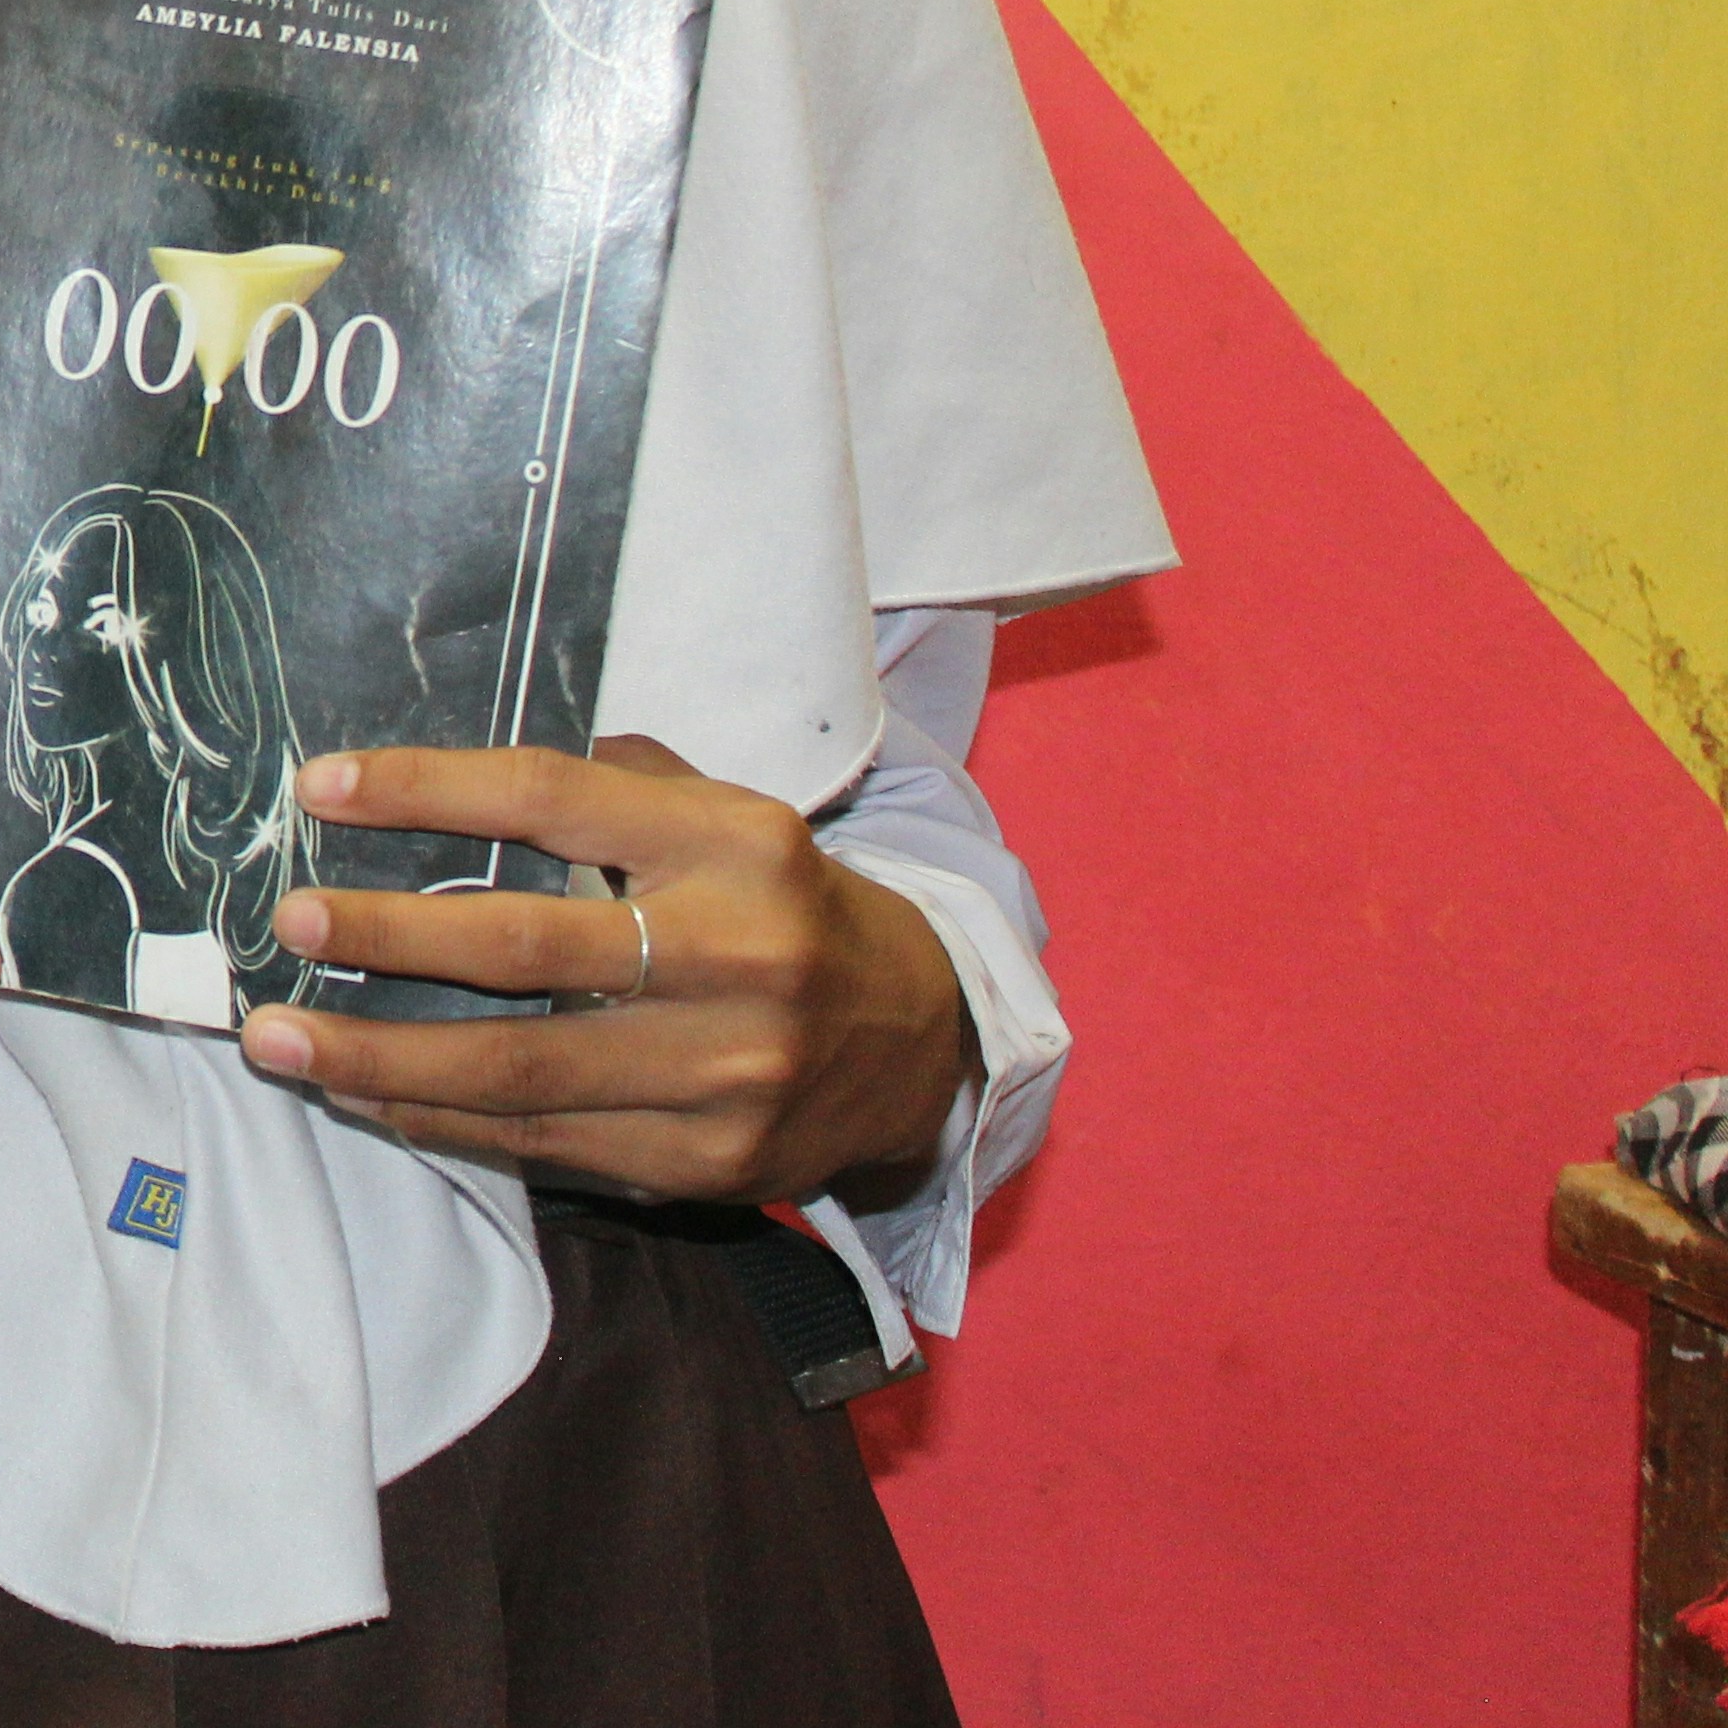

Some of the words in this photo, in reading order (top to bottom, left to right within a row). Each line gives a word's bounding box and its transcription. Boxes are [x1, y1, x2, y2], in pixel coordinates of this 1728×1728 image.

[135, 3, 263, 39] AMEYLIA
[278, 24, 420, 63] FALENSIA
[394, 9, 450, 33] Dari
